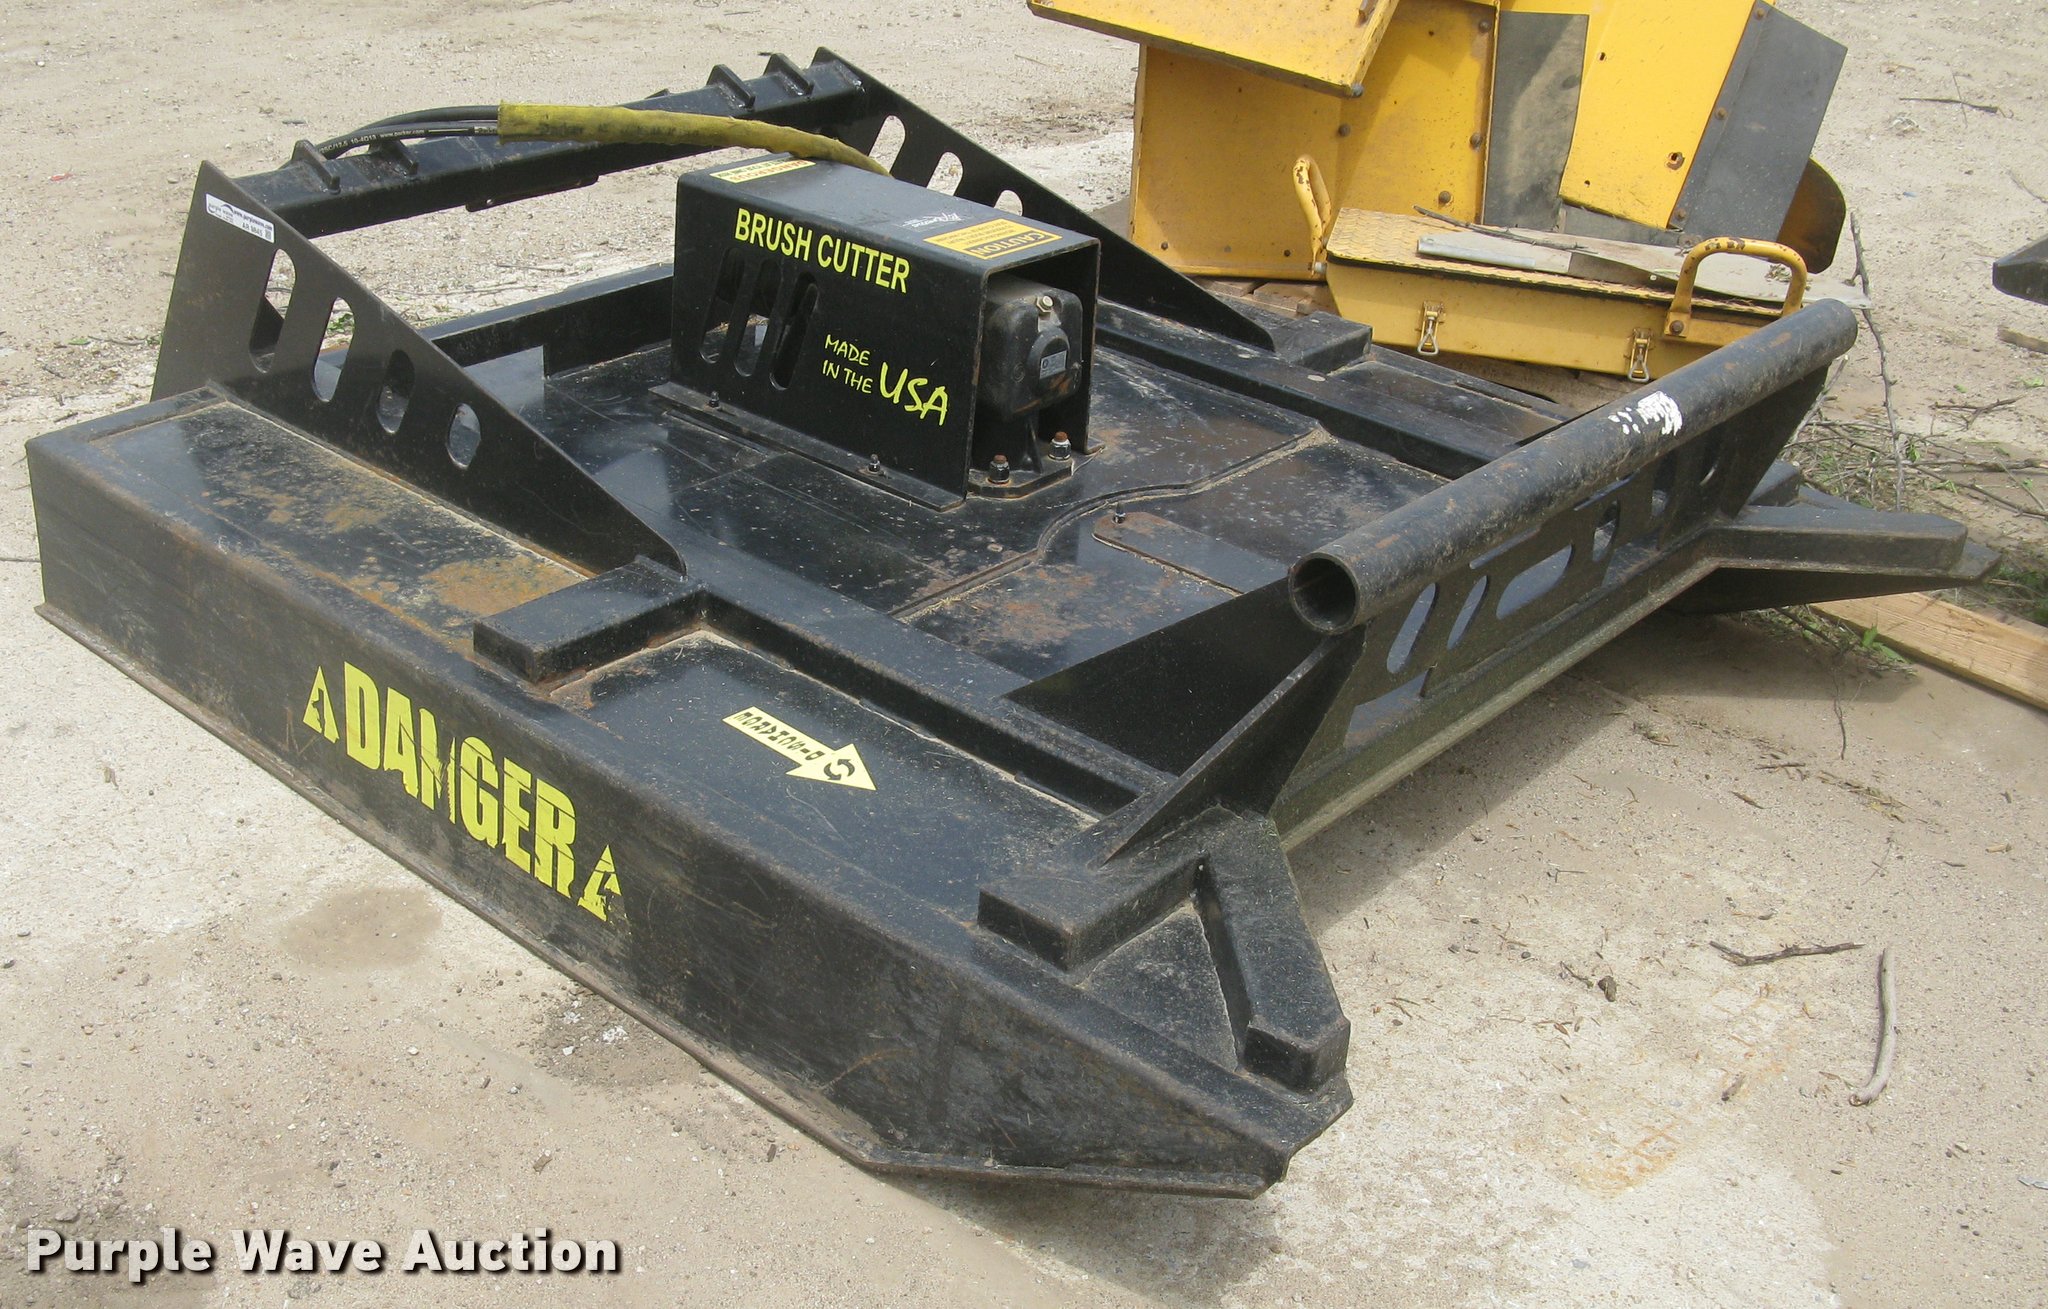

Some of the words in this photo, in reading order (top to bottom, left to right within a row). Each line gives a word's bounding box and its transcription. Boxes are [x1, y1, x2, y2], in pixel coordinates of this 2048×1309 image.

[735, 207, 813, 262] BRUSH
[817, 234, 910, 294] CUTTER
[970, 232, 1046, 255] CAUTION
[824, 334, 871, 366] MADE
[822, 359, 840, 380] IN
[844, 368, 874, 394] THE
[879, 362, 949, 427] USA
[343, 660, 577, 899] DANGER
